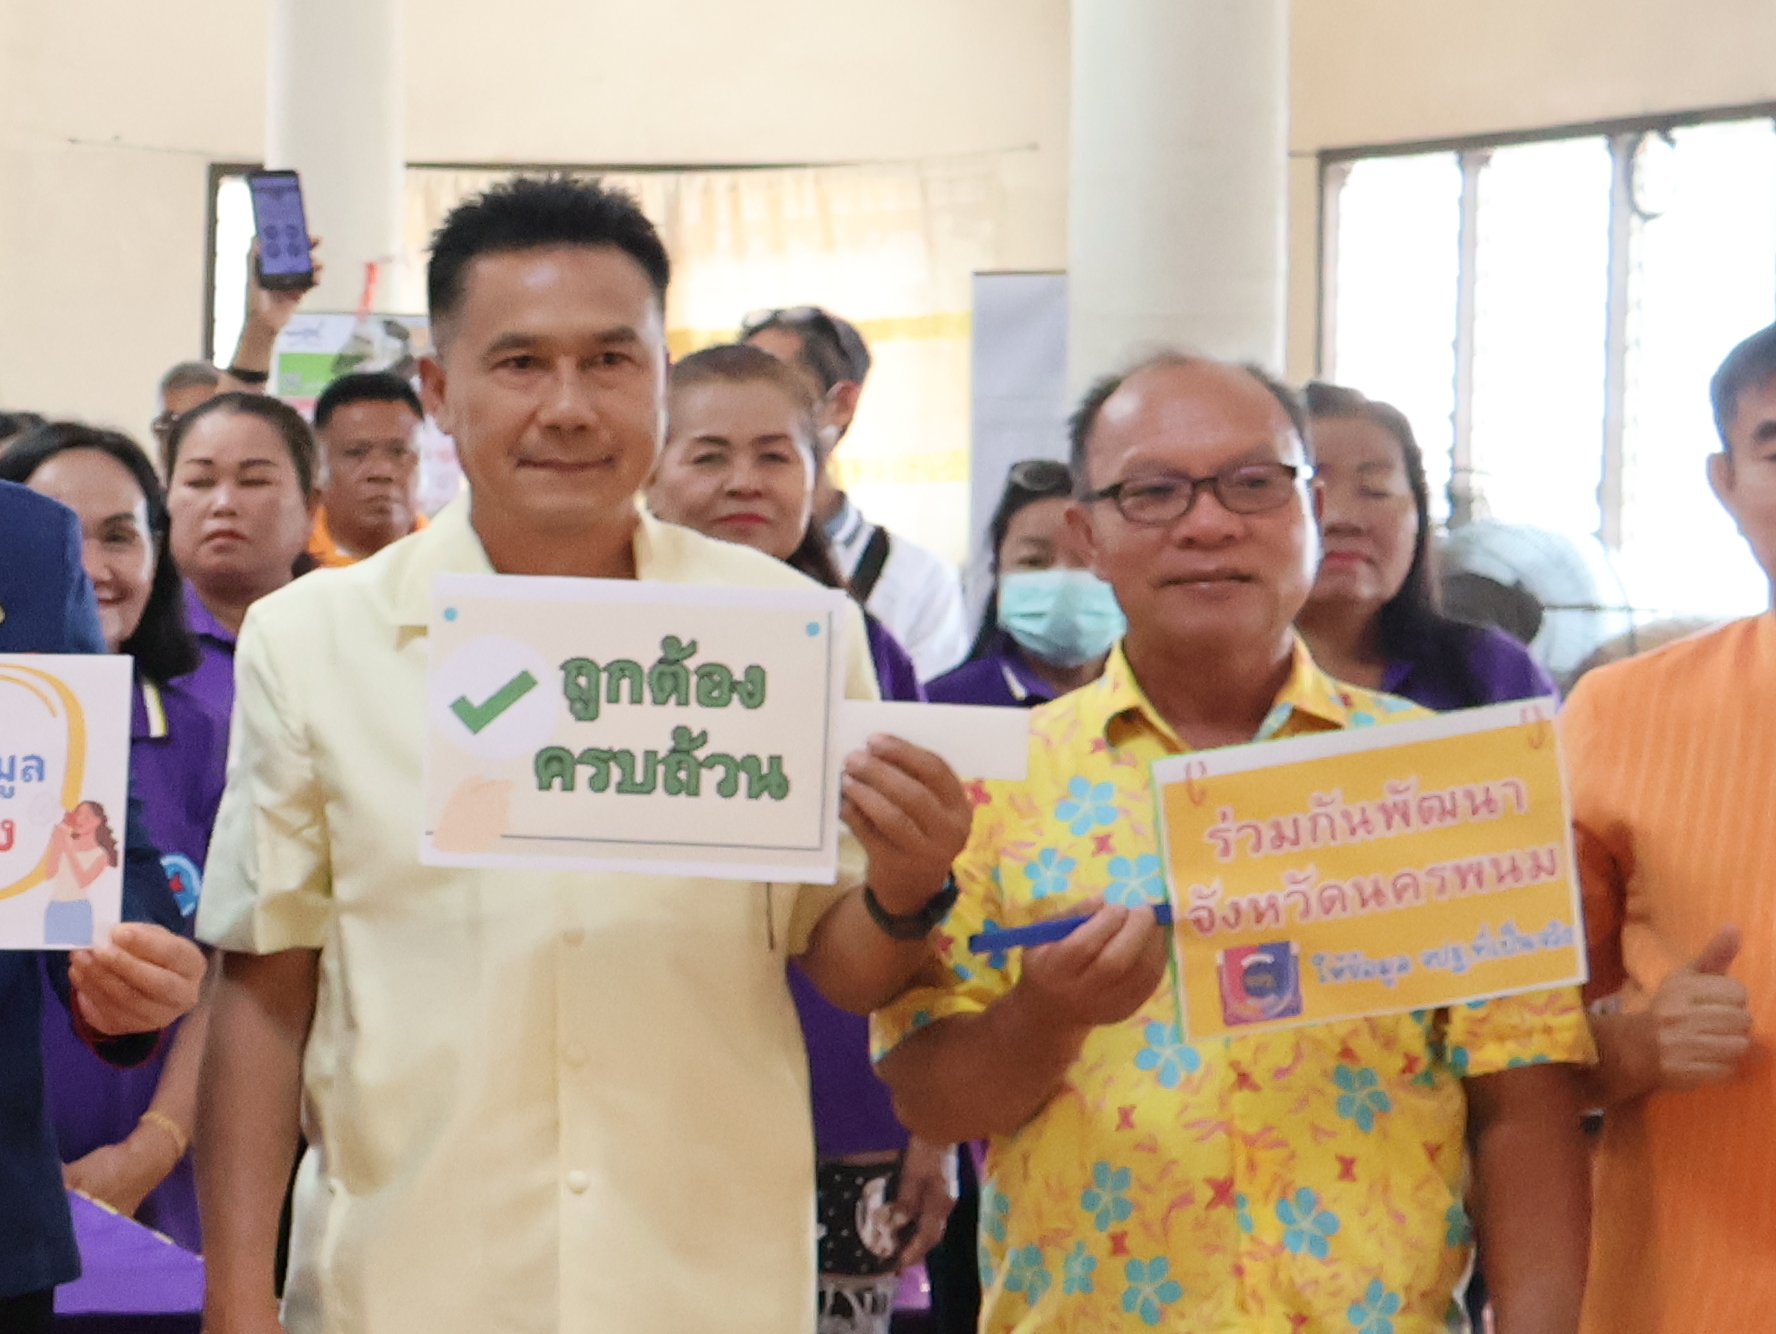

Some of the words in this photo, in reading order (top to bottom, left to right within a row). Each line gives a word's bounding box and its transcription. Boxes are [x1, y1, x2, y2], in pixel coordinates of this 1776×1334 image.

[559, 633, 768, 722] ถูกต้อง
[534, 724, 790, 801] ครบถ้วน
[1205, 776, 1530, 862] ร่วมกันพัฒนา
[1187, 843, 1561, 938] จังหวัดนครพนม
